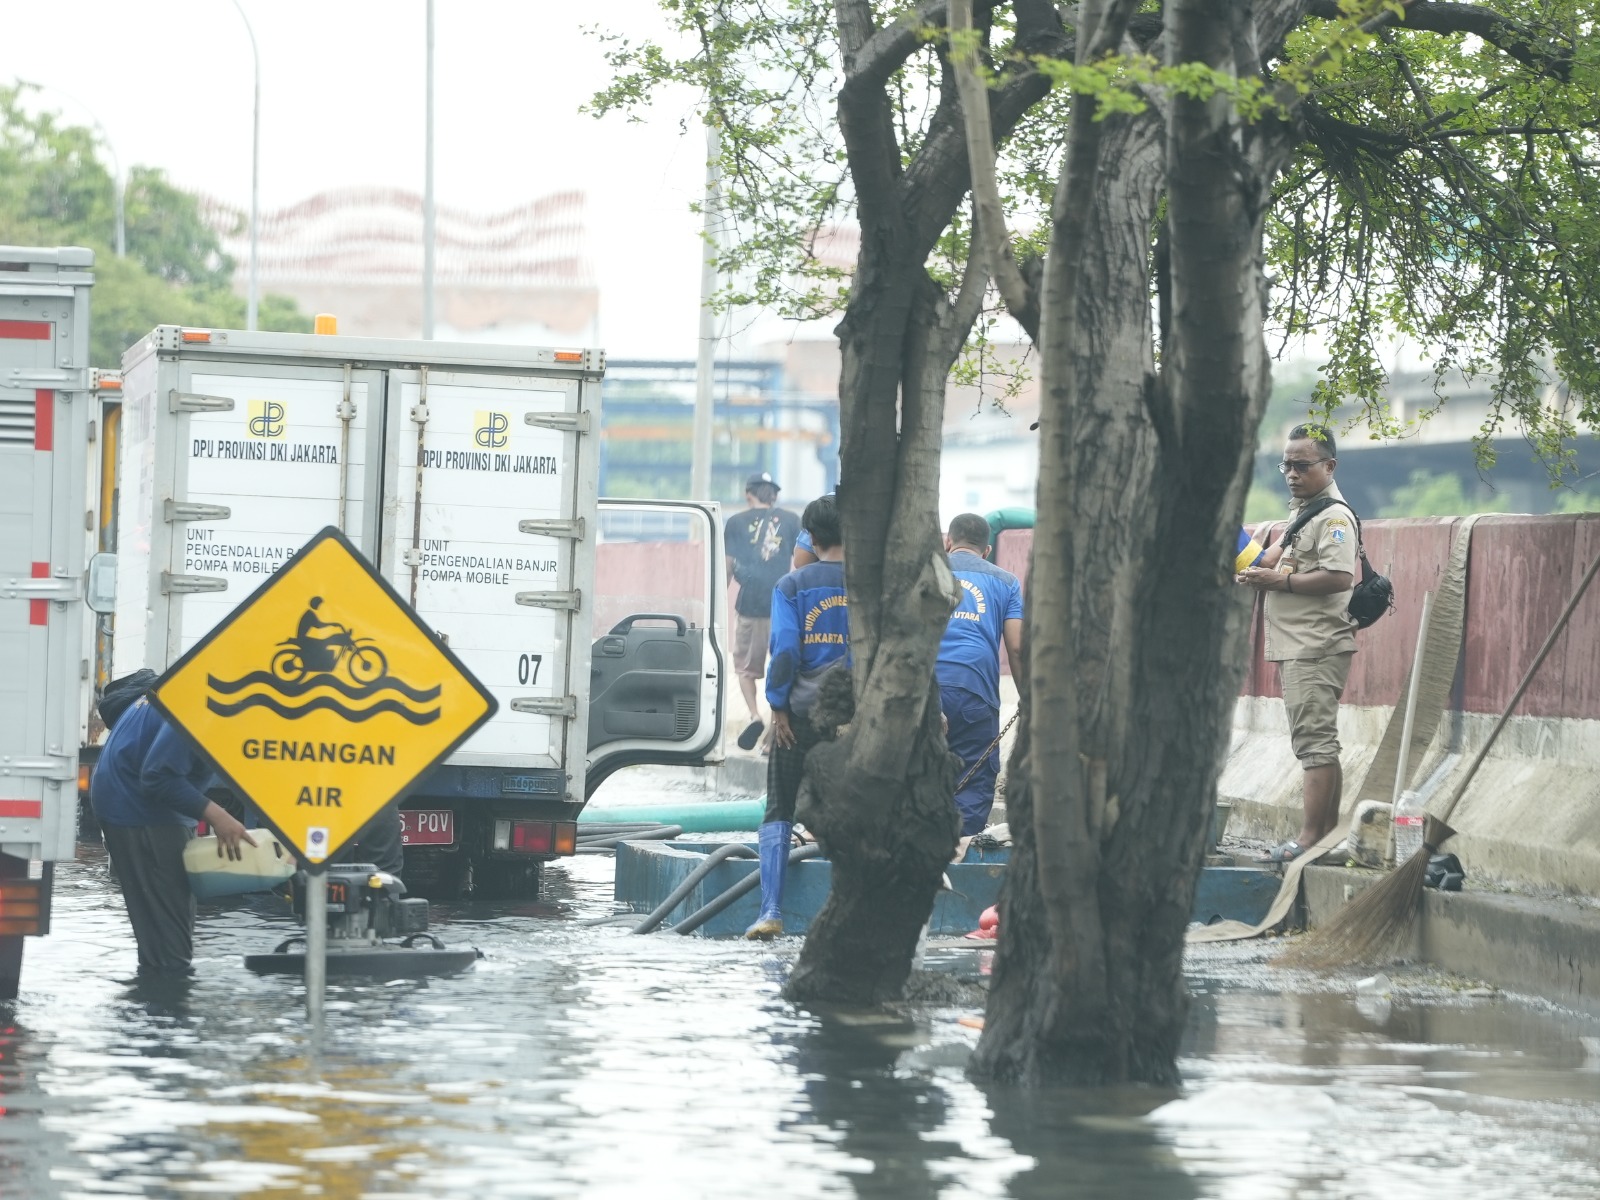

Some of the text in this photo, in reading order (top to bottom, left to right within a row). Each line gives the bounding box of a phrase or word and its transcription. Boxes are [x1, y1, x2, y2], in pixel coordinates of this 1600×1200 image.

[193, 439, 337, 464] DPU PROVINSI DKI JAKARTA
[422, 450, 557, 475] DPU PROVINSI DKI JAKARTA
[187, 528, 215, 541] UNIT
[186, 543, 283, 559] PENGENDALIAN
[424, 539, 450, 552] UNIT
[185, 559, 279, 574] POMPA MOBILE
[422, 554, 557, 573] PENGENDALIAN BANJIR
[422, 569, 509, 585] POMPA MOBILE
[819, 595, 848, 610] SUMBE
[954, 611, 980, 622] UTARA
[804, 633, 844, 645] JAKARTA
[518, 653, 542, 686] 07
[242, 738, 395, 766] GENANGAN
[296, 786, 342, 808] AIR
